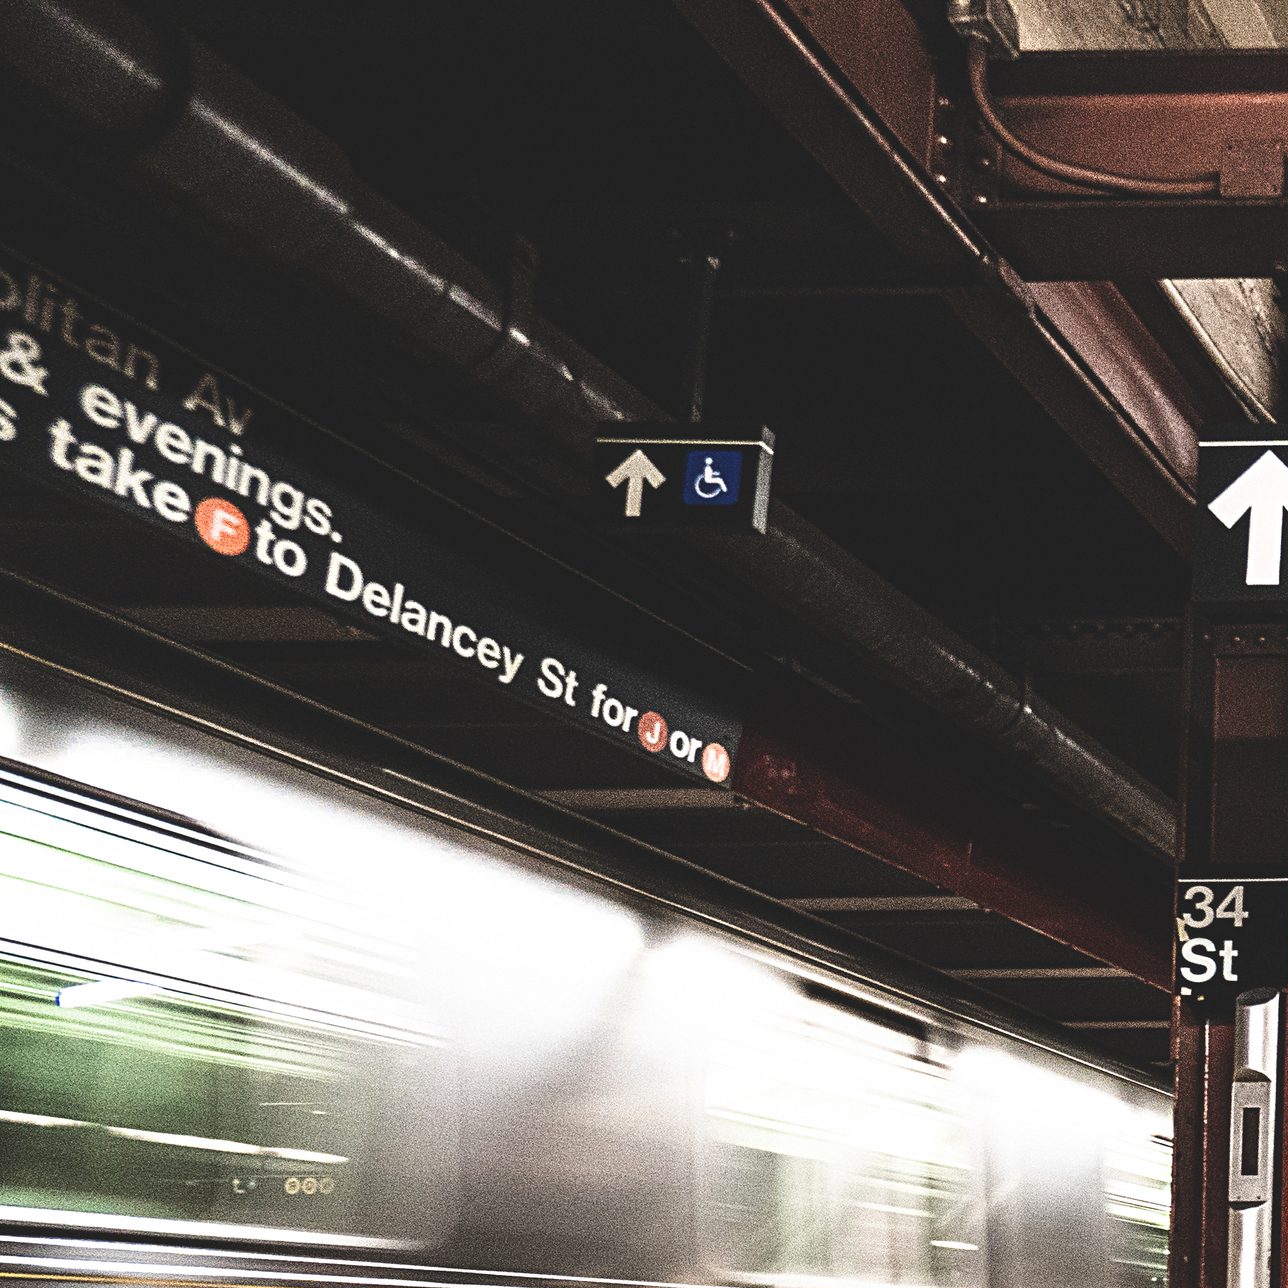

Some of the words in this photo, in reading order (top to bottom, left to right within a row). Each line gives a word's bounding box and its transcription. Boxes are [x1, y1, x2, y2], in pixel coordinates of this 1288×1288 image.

[182, 372, 254, 436] Av
[0, 330, 48, 398] &
[79, 382, 343, 543] evenings.
[50, 416, 192, 523] take
[210, 508, 240, 541] F
[254, 518, 307, 577] to
[324, 551, 524, 684] Delancey
[537, 656, 579, 707] St
[590, 683, 639, 733] for
[669, 730, 703, 763] or
[1182, 885, 1249, 929] 34
[1180, 937, 1239, 983] St
